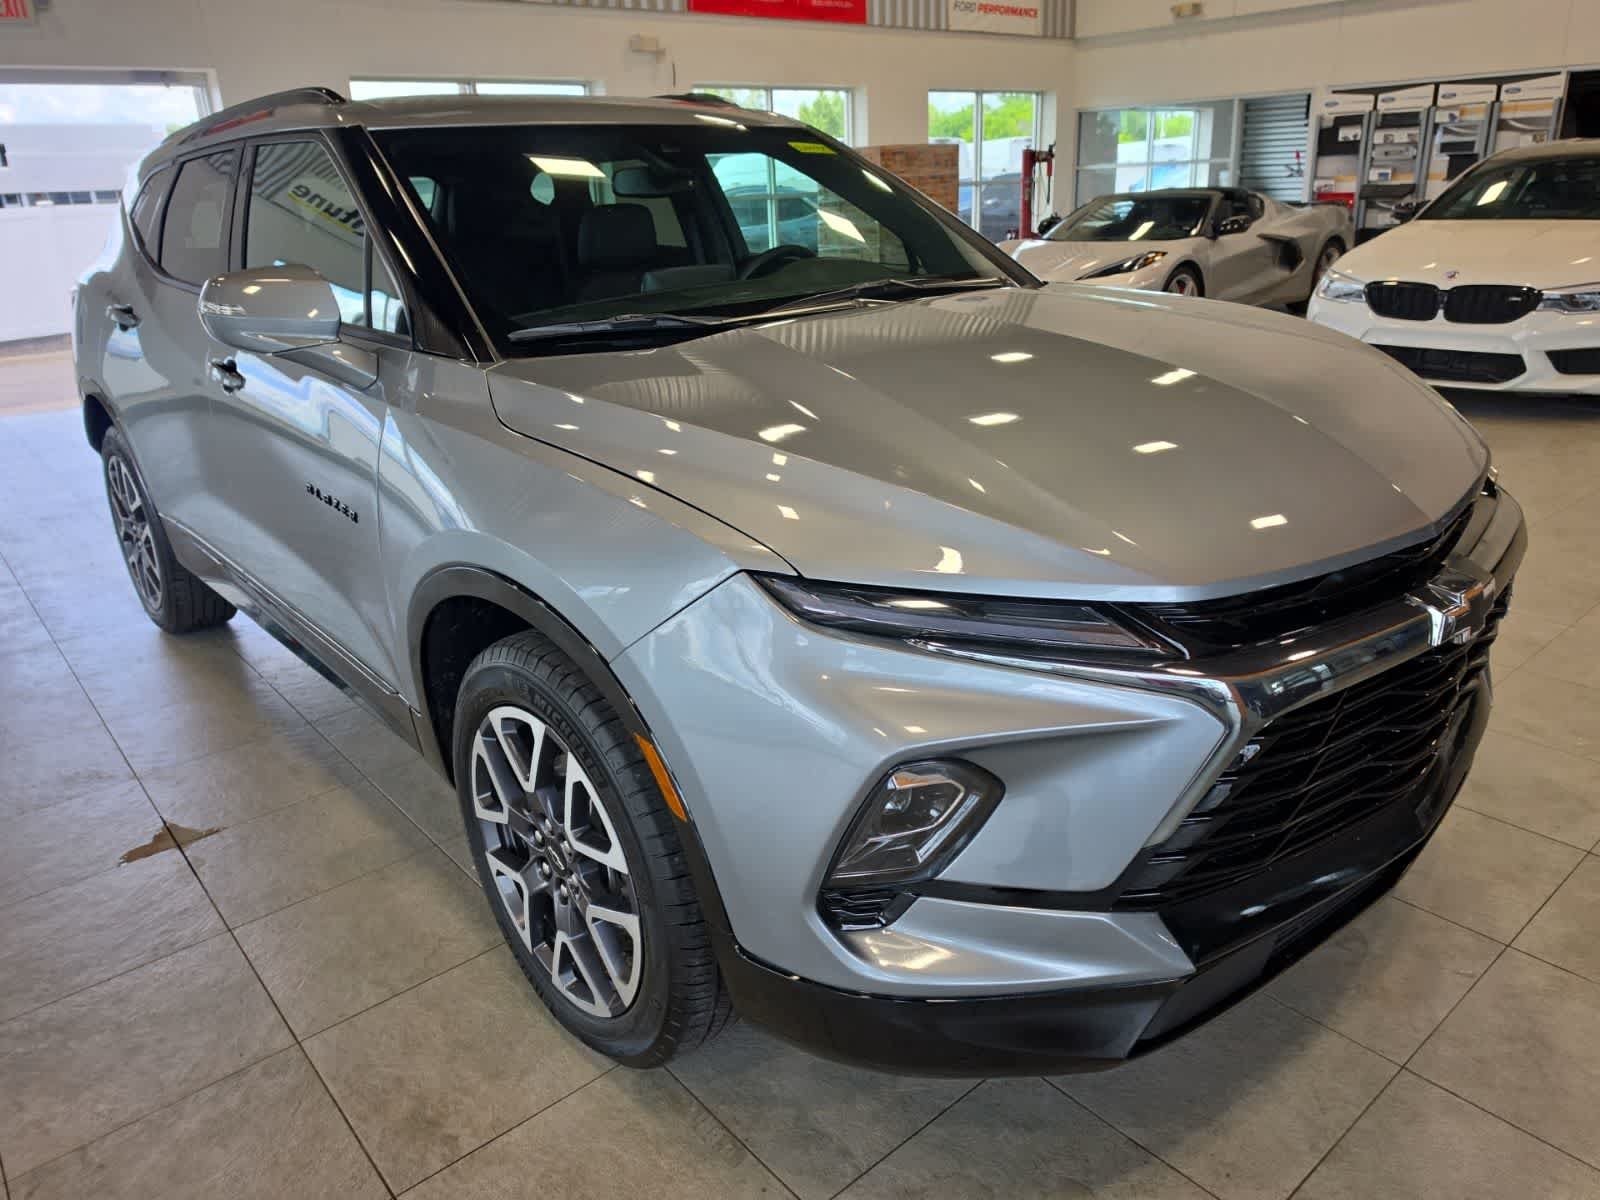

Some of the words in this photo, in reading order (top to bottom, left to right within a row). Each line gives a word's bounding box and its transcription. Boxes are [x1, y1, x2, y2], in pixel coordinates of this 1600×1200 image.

[953, 1, 976, 13] FORD
[977, 3, 1038, 18] PERFORMANCE
[305, 482, 359, 524] BLAZER
